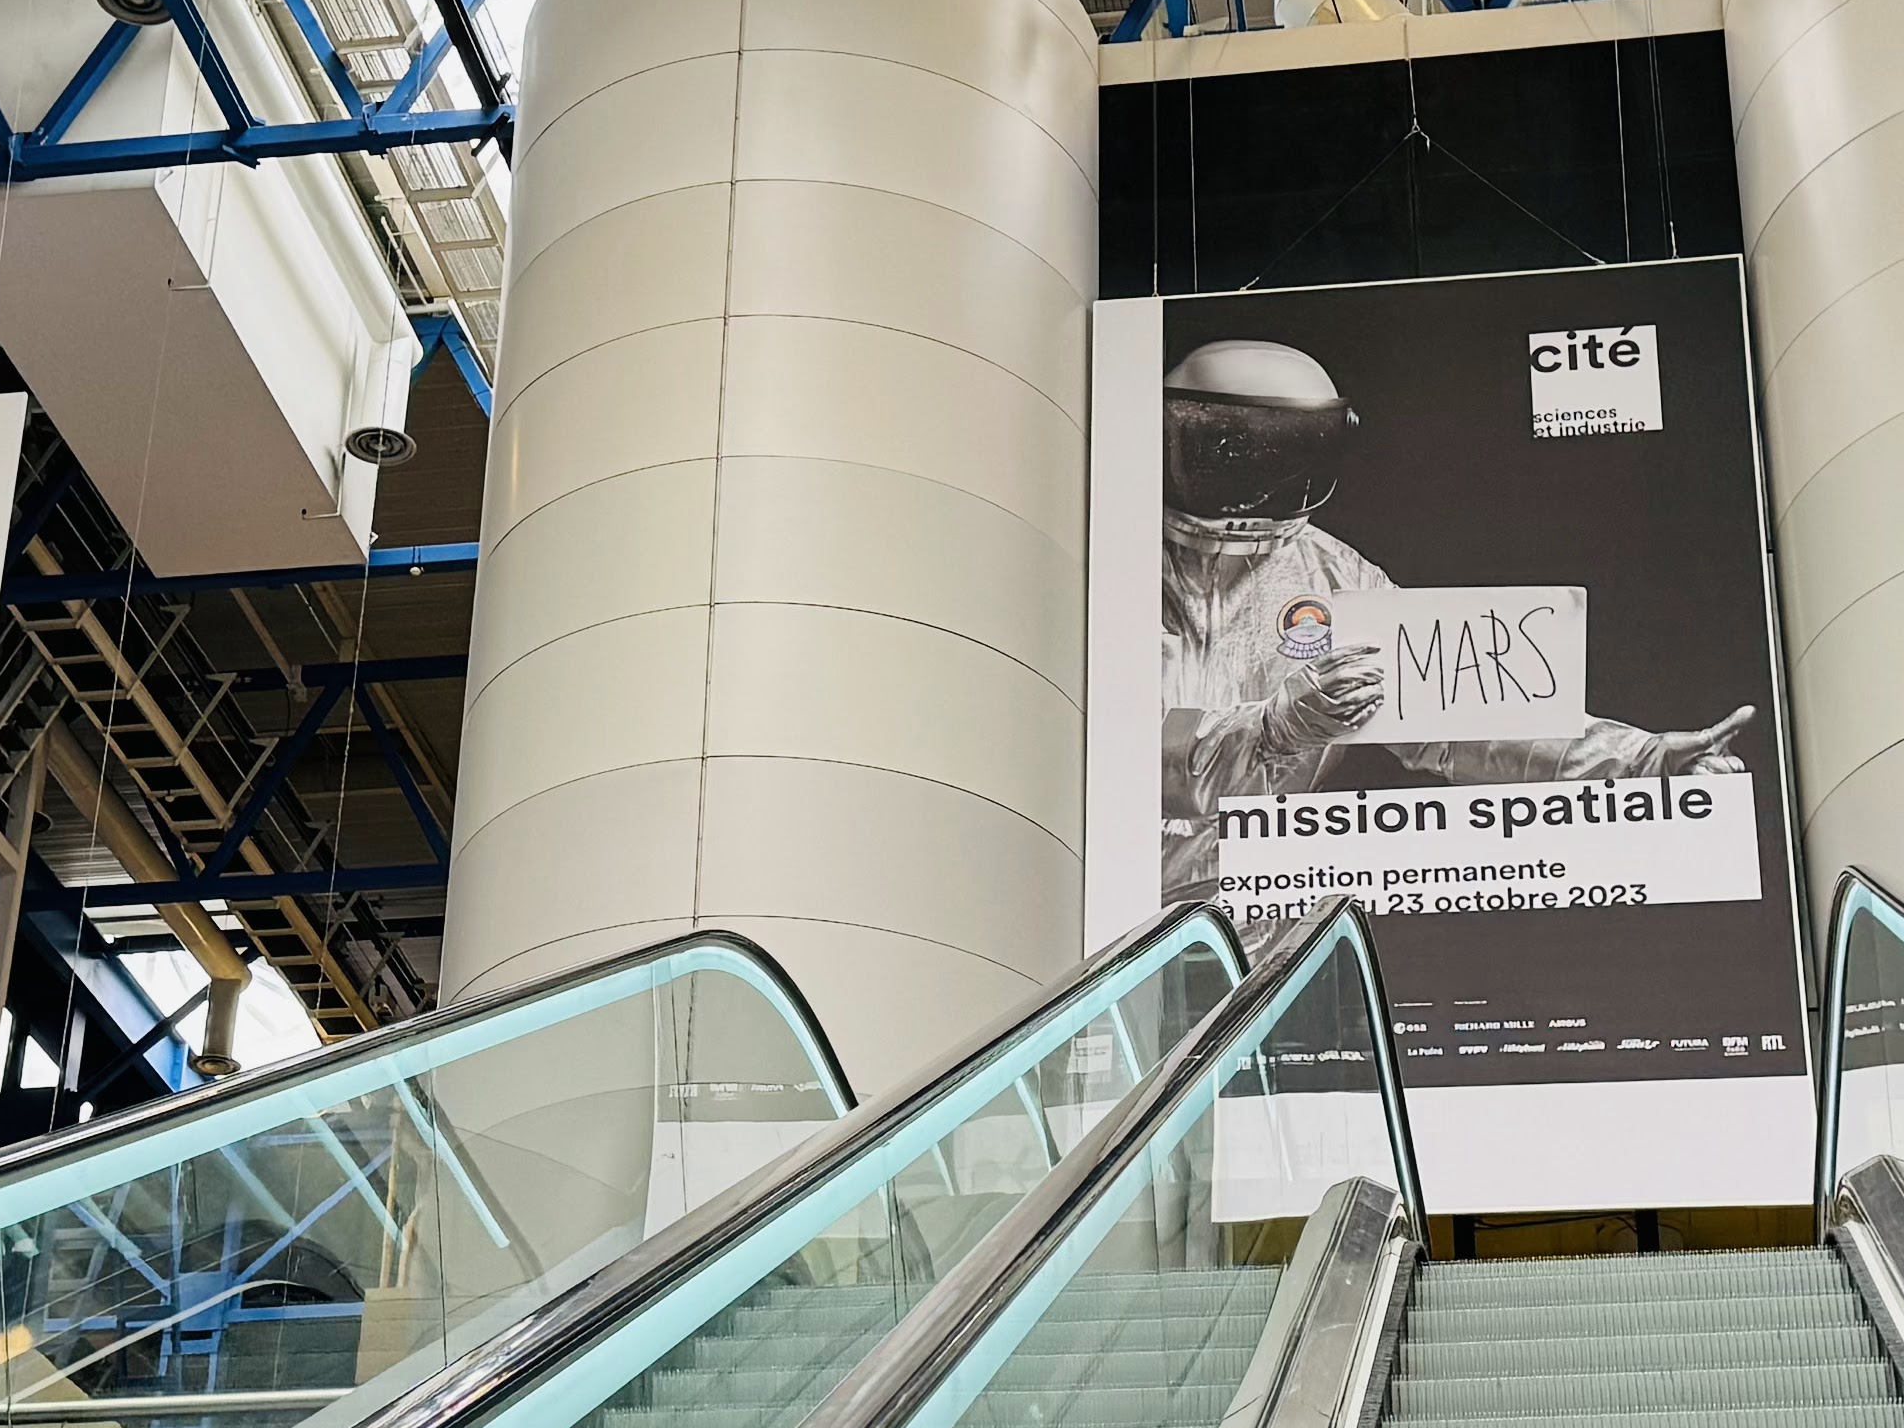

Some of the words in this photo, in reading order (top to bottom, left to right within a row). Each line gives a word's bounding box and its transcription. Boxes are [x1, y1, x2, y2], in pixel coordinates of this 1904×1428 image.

[1530, 325, 1640, 373] cité
[1533, 408, 1617, 423] sciences
[1534, 423, 1553, 438] et
[1559, 418, 1645, 436] industrie
[1398, 607, 1556, 720] MARS
[1219, 789, 1447, 840] mission
[1469, 776, 1713, 838] spatiale
[1220, 865, 1373, 896] exposition
[1383, 859, 1566, 890] permanente
[1387, 893, 1424, 915] 23
[1435, 887, 1558, 913] octobre
[1569, 884, 1648, 907] 2023
[1670, 1038, 1709, 1048] FUTURA
[1761, 1034, 1787, 1051] RTL
